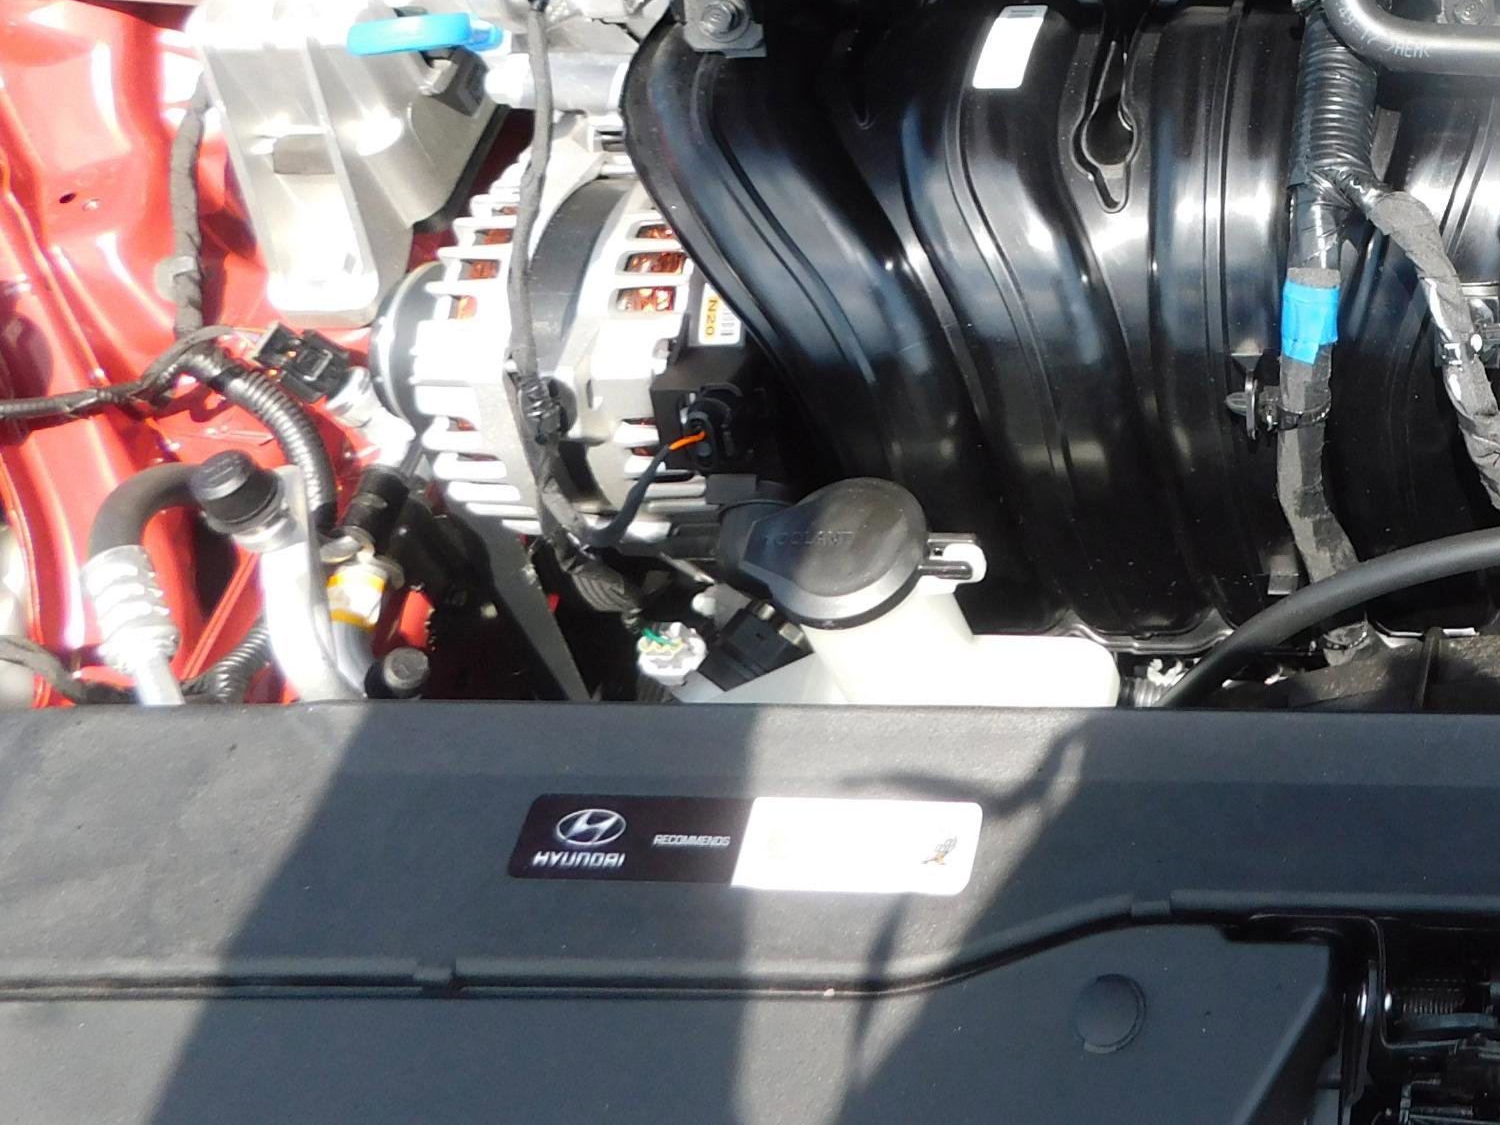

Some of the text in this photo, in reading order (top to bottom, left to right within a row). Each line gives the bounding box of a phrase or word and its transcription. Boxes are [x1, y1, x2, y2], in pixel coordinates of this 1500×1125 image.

[704, 299, 718, 337] N20
[764, 529, 855, 545] OOLANT
[531, 832, 731, 869] HYUNDAI RECOMMENDS
